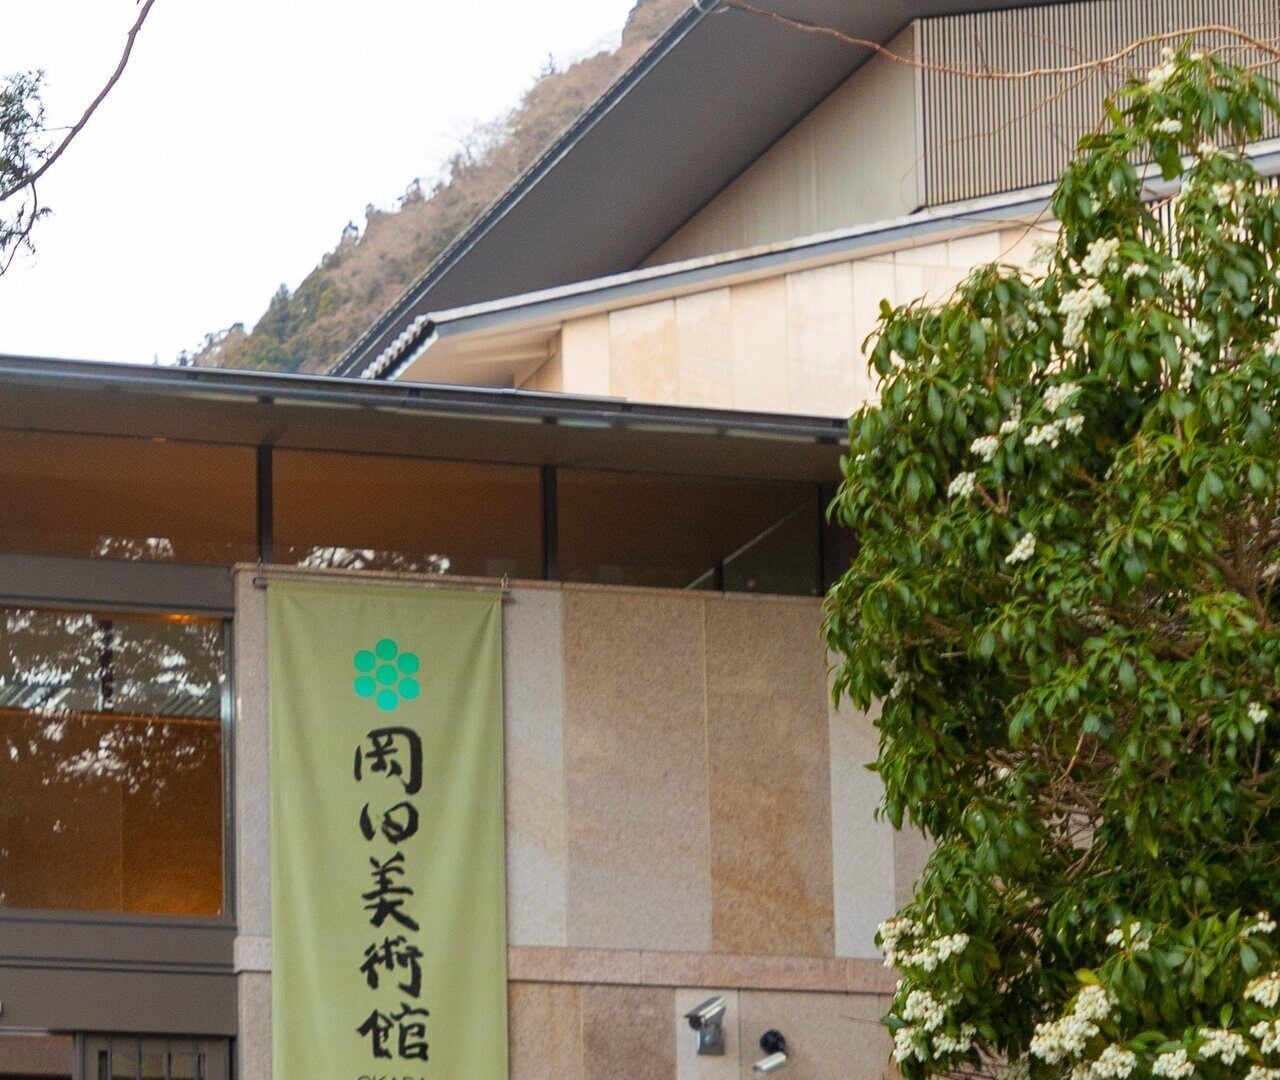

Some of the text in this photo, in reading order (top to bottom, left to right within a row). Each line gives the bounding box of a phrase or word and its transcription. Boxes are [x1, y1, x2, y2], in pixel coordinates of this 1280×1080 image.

[353, 726, 429, 1062] 岡田美術館
